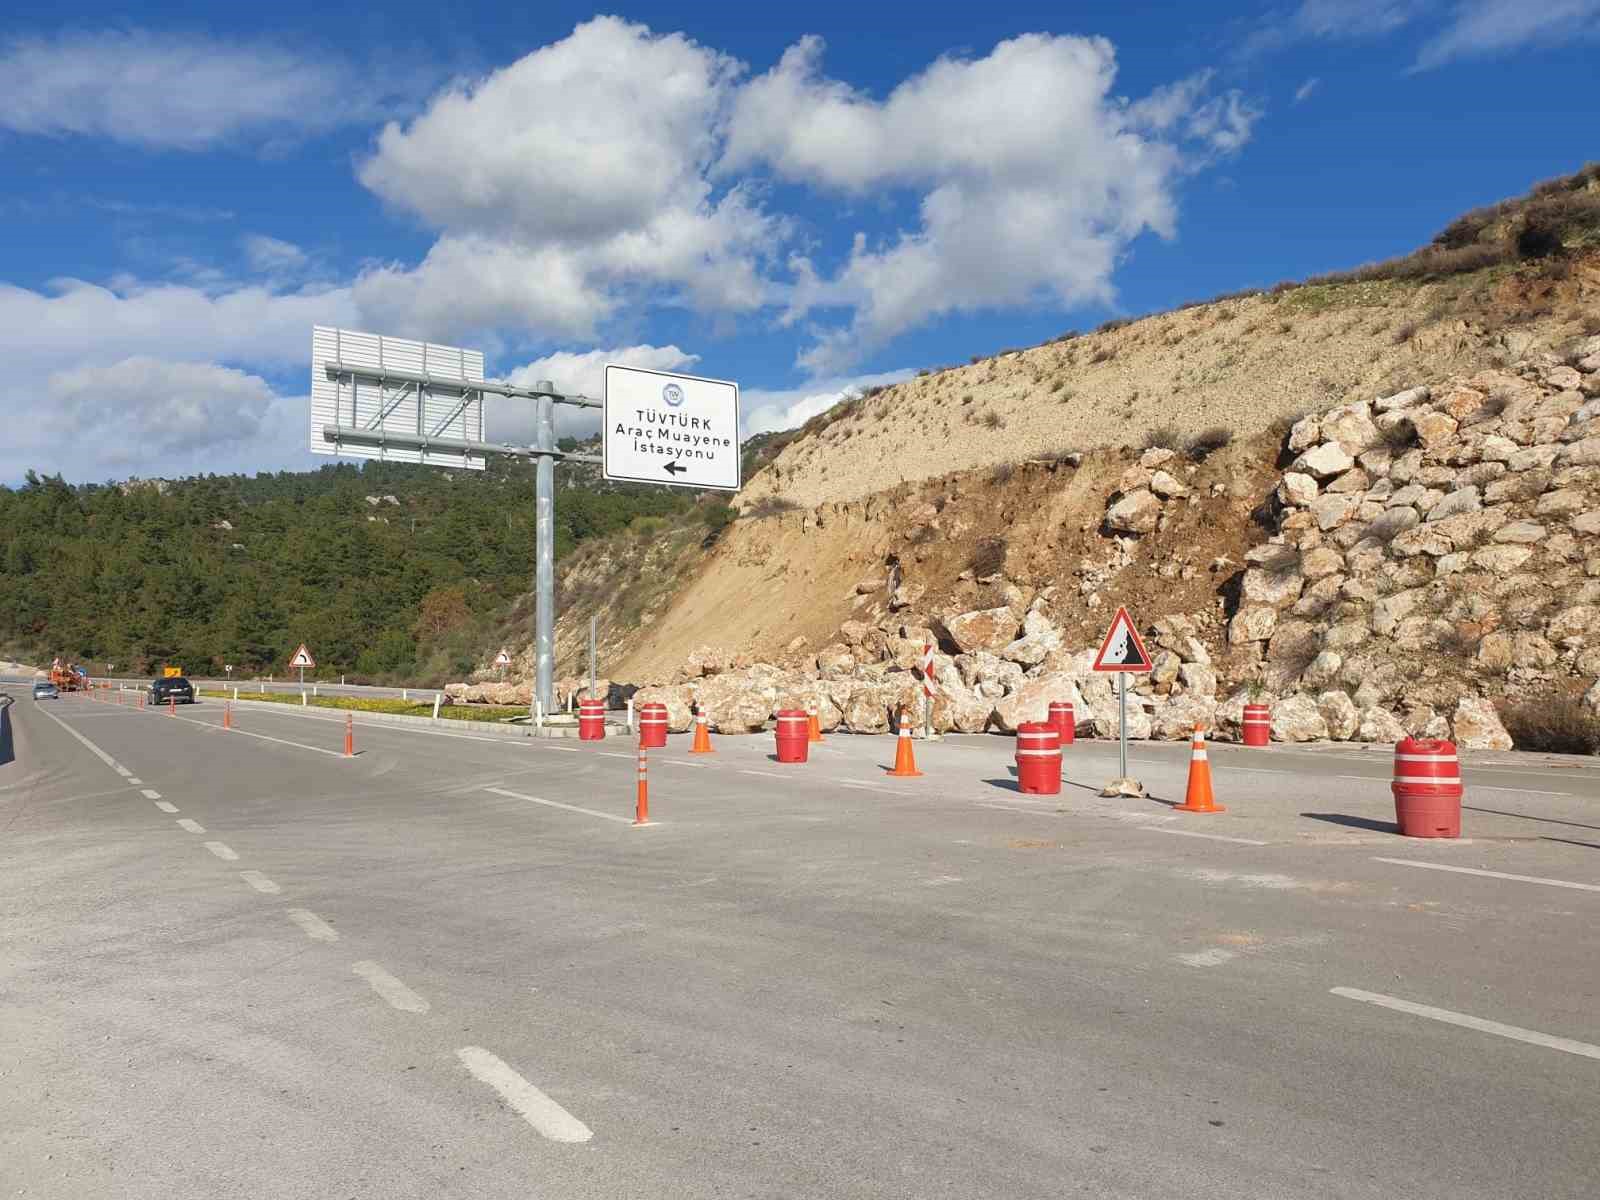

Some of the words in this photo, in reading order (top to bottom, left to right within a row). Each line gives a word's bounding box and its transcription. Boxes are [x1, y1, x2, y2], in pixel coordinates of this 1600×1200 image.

[636, 409, 711, 430] TÜVTÜRK
[616, 423, 653, 439] Araç
[658, 428, 730, 447] Muayene
[634, 437, 714, 459] İstasyonu
